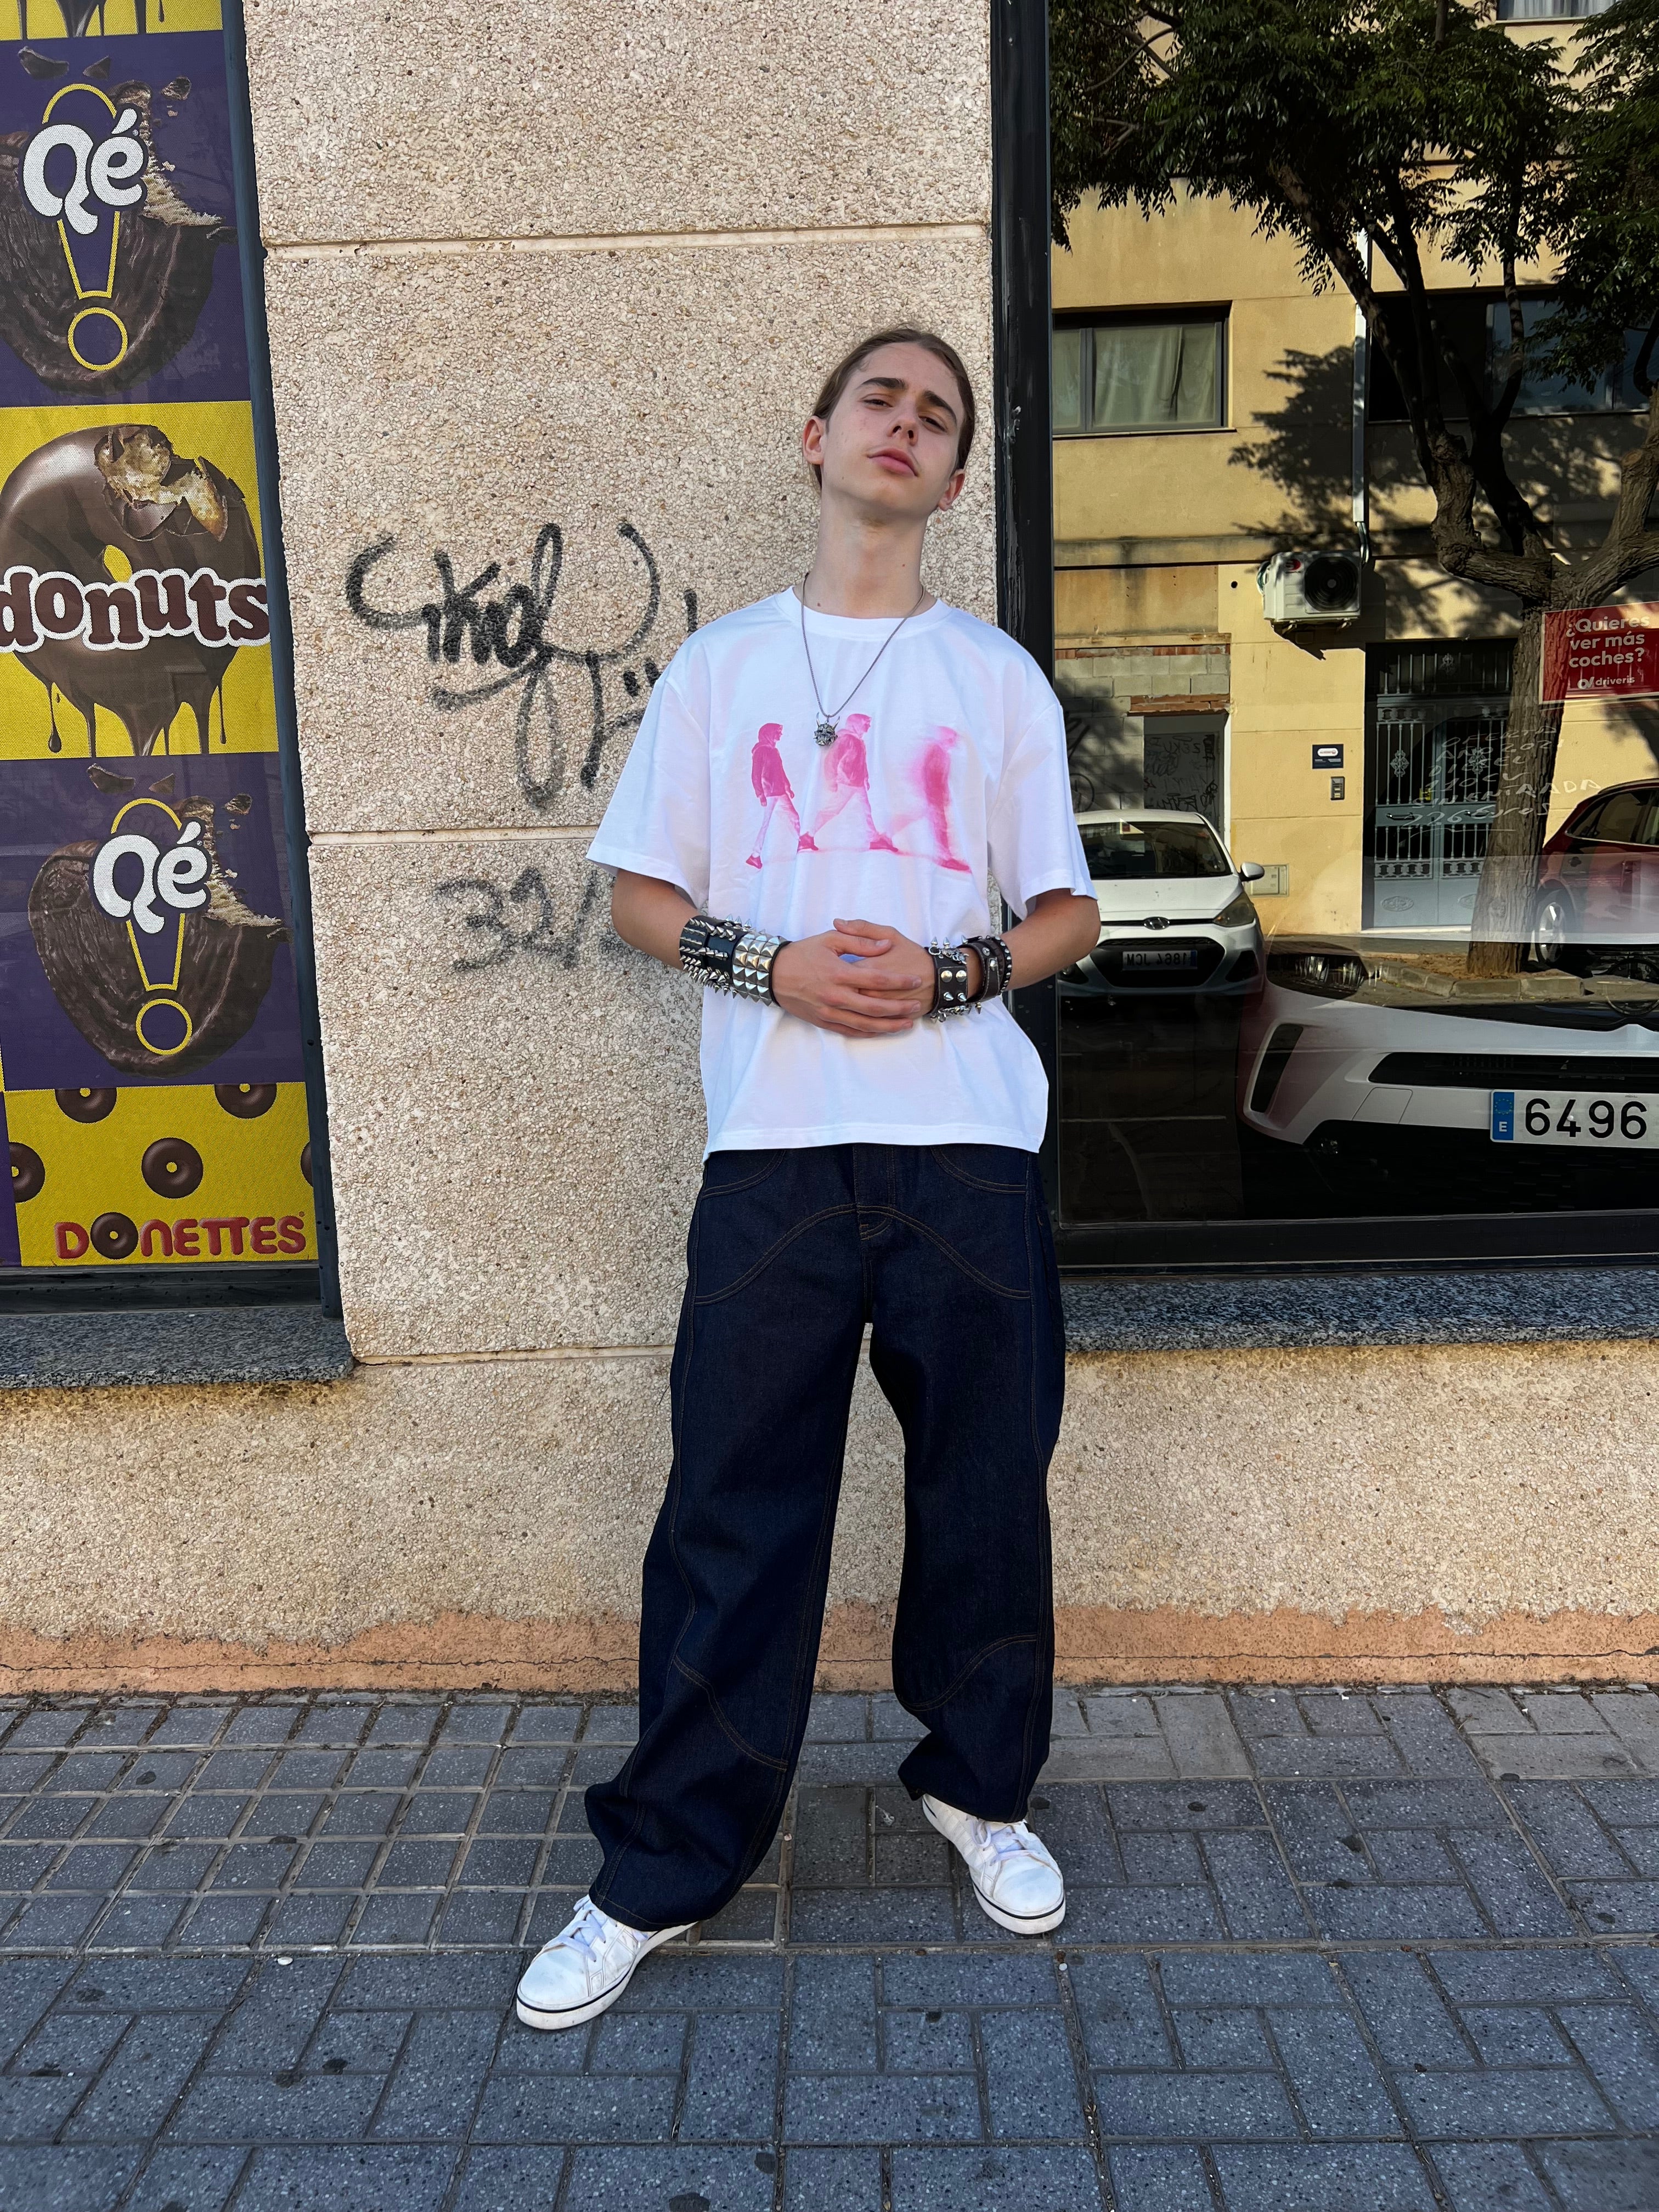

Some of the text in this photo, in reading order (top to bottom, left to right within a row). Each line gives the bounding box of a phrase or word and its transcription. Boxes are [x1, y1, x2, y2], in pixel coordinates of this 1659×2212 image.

[0, 566, 270, 652] donuts
[1566, 616, 1650, 637] ¿Quieres
[1570, 631, 1645, 650] ver más
[1569, 647, 1645, 668] coches?
[1595, 675, 1635, 686] driveris
[1499, 1098, 1647, 1140] E 6496
[54, 1212, 307, 1260] DONETTES
